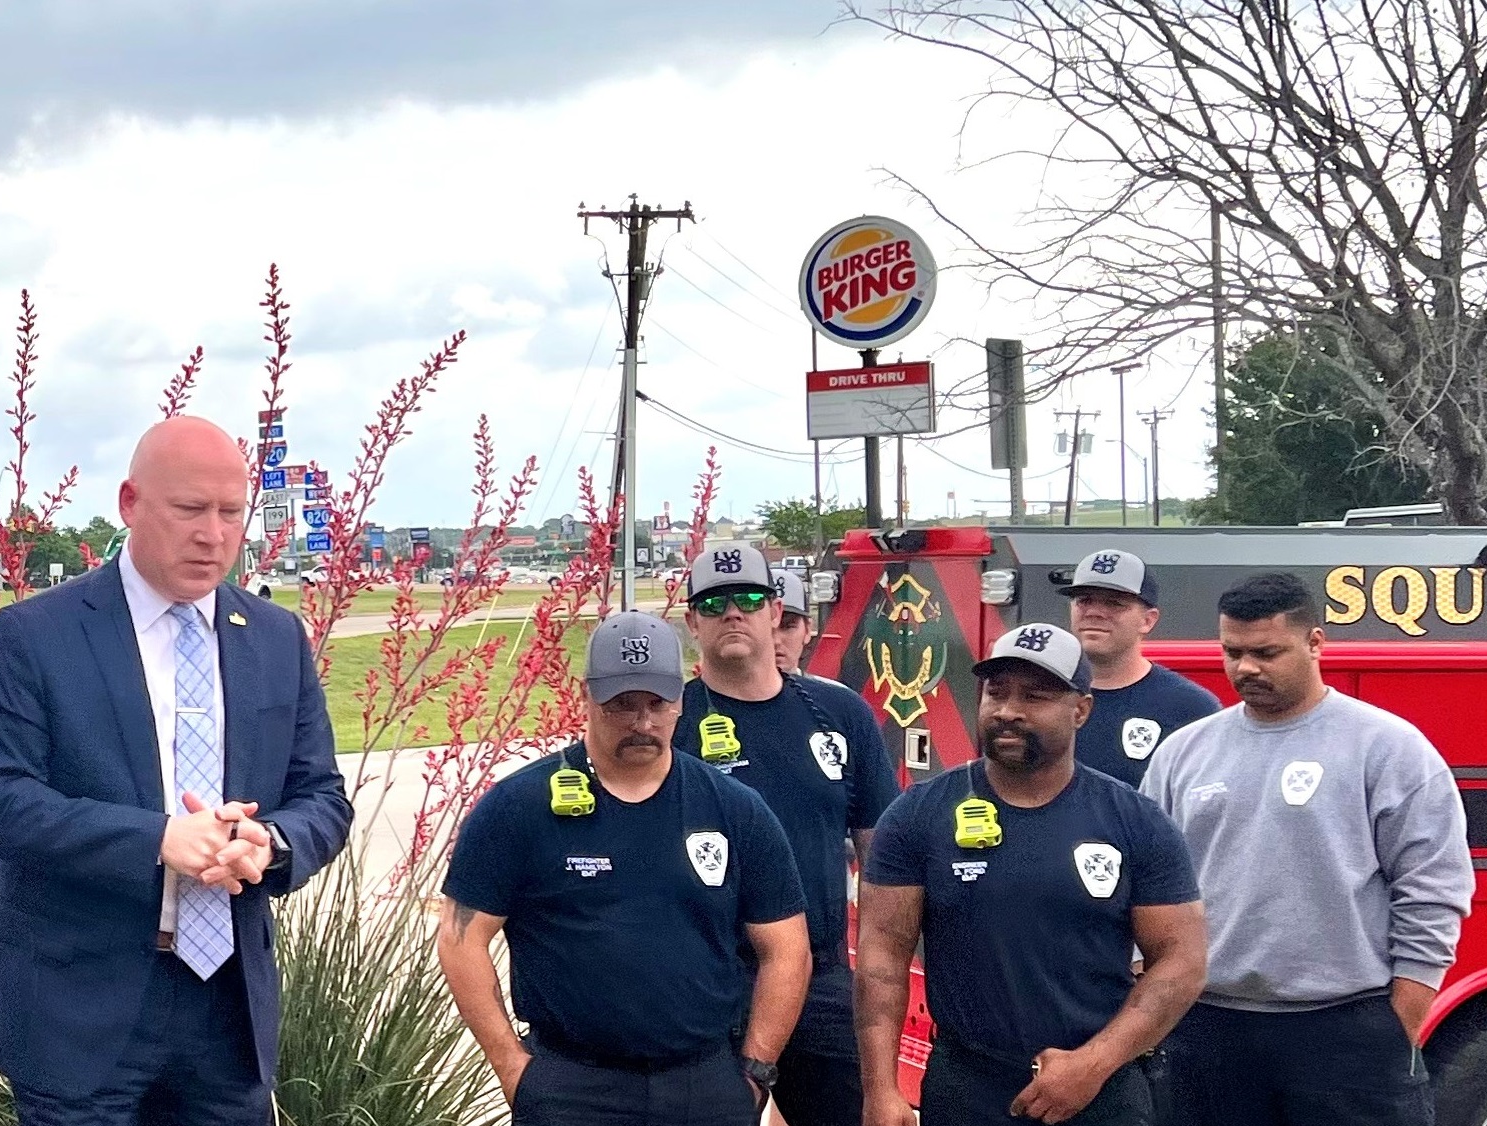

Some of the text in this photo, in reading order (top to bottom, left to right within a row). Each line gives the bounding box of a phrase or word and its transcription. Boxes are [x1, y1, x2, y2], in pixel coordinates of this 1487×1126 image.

[817, 239, 912, 291] BURGER
[822, 260, 917, 322] KING
[829, 371, 906, 387] DRIVE THRU
[264, 472, 282, 481] LEFT
[265, 480, 283, 489] LANE
[265, 493, 284, 503] EAST
[268, 510, 284, 519] 199
[306, 511, 329, 525] 820
[308, 533, 329, 542] RIGHT
[309, 541, 329, 550] LANE
[1325, 565, 1487, 637] SQU
